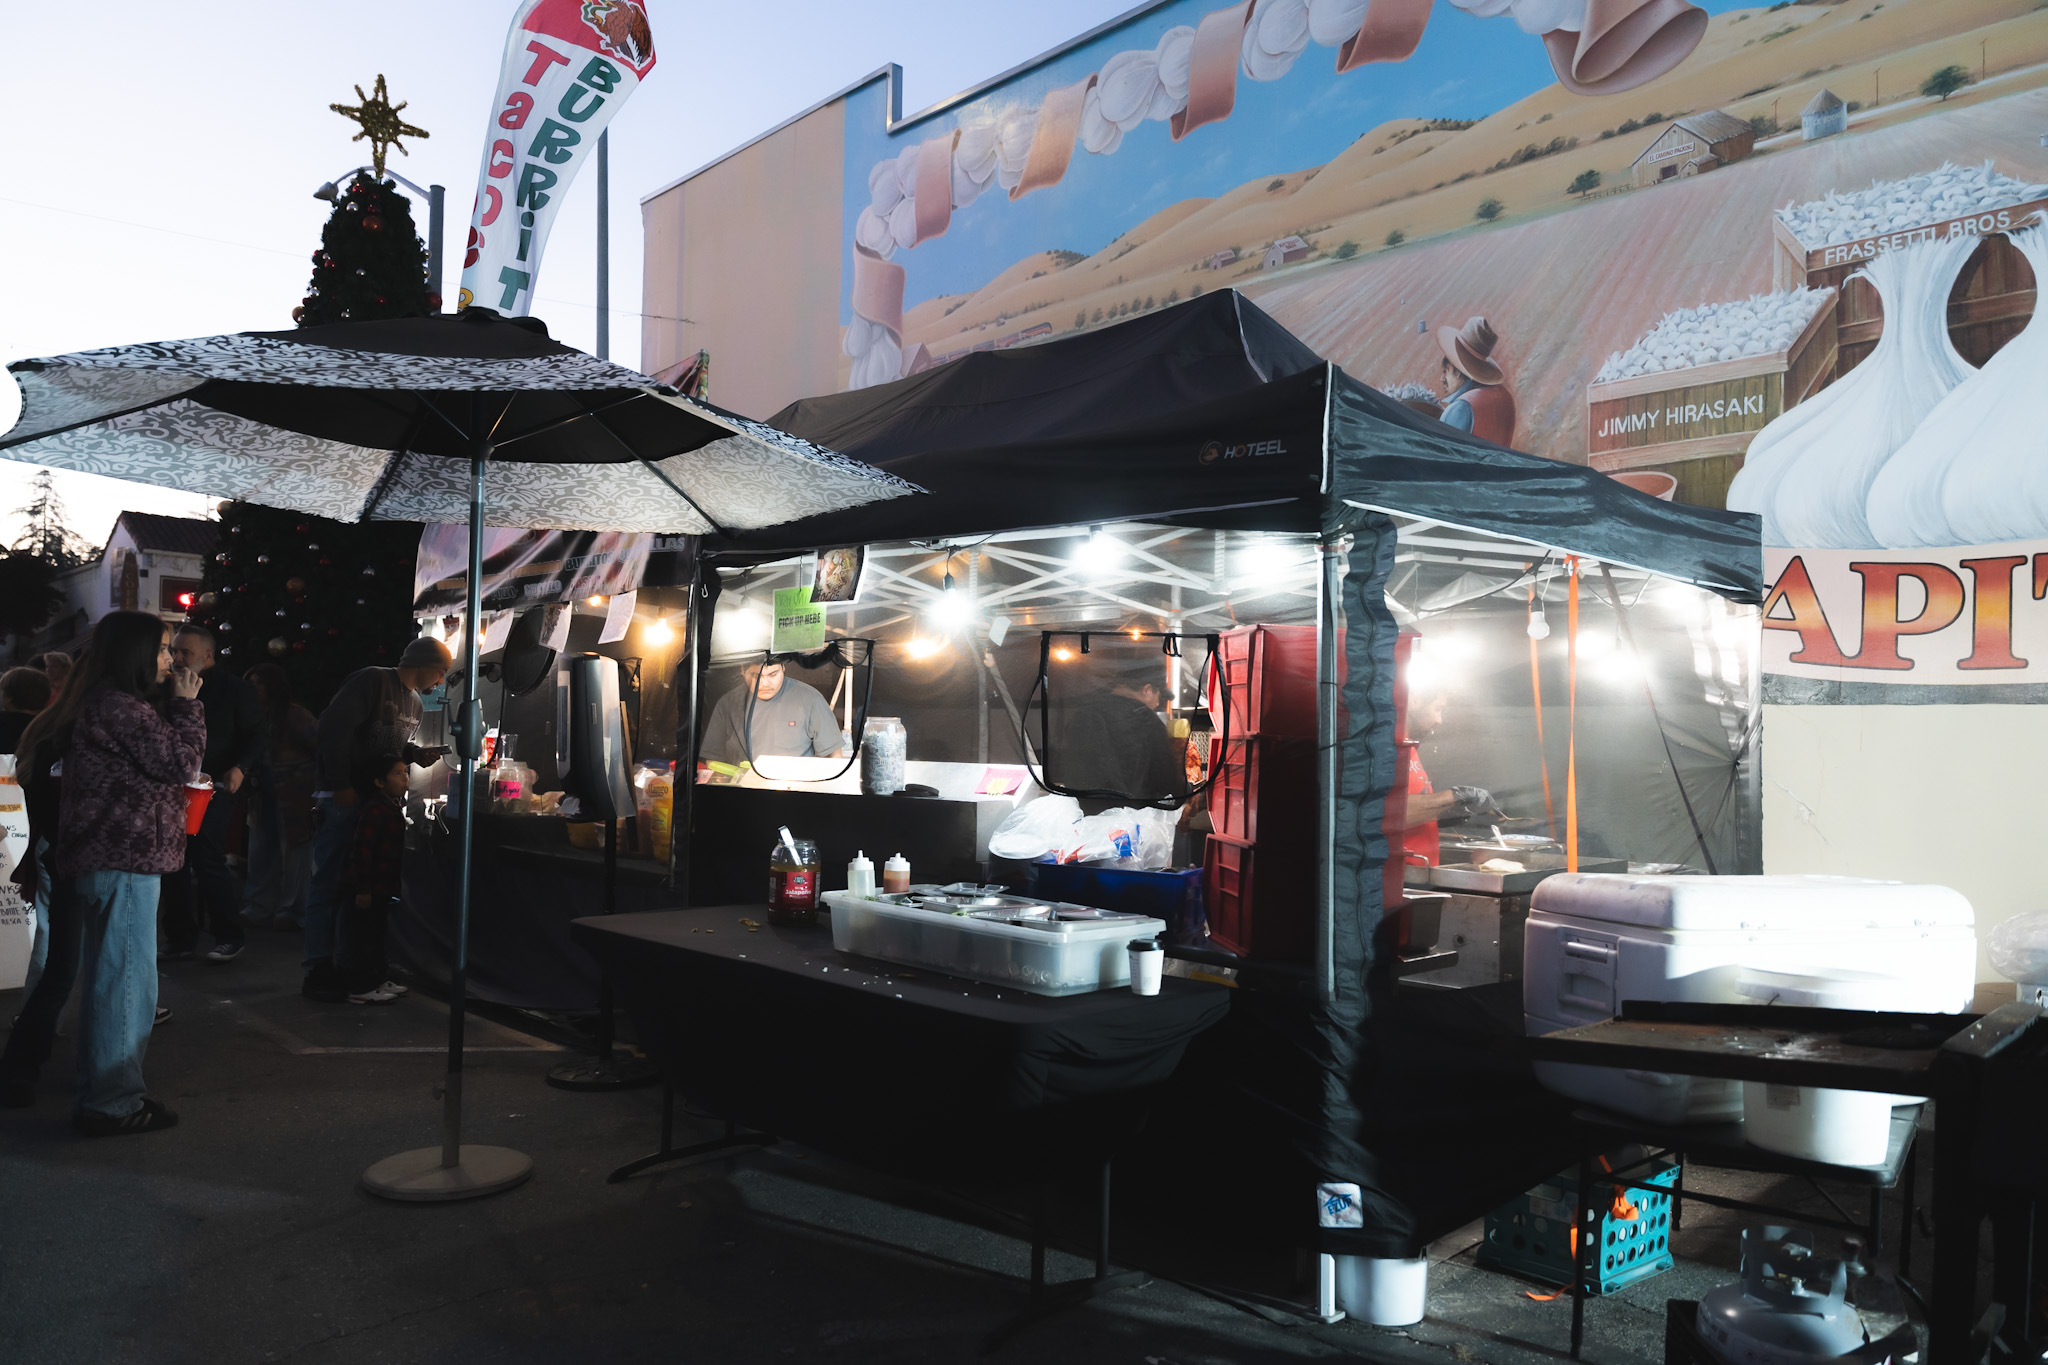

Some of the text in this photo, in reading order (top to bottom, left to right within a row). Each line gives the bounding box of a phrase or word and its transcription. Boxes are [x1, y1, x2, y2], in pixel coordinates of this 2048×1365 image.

[1655, 149, 1673, 160] CAMINO
[1824, 210, 2011, 266] FRASSETTI BROS
[1598, 394, 1764, 438] JIMMY HIRASAKI
[1224, 440, 1287, 459] HOTEEL
[778, 617, 794, 629] PICK
[804, 612, 821, 625] HERE
[1762, 552, 2048, 671] API
